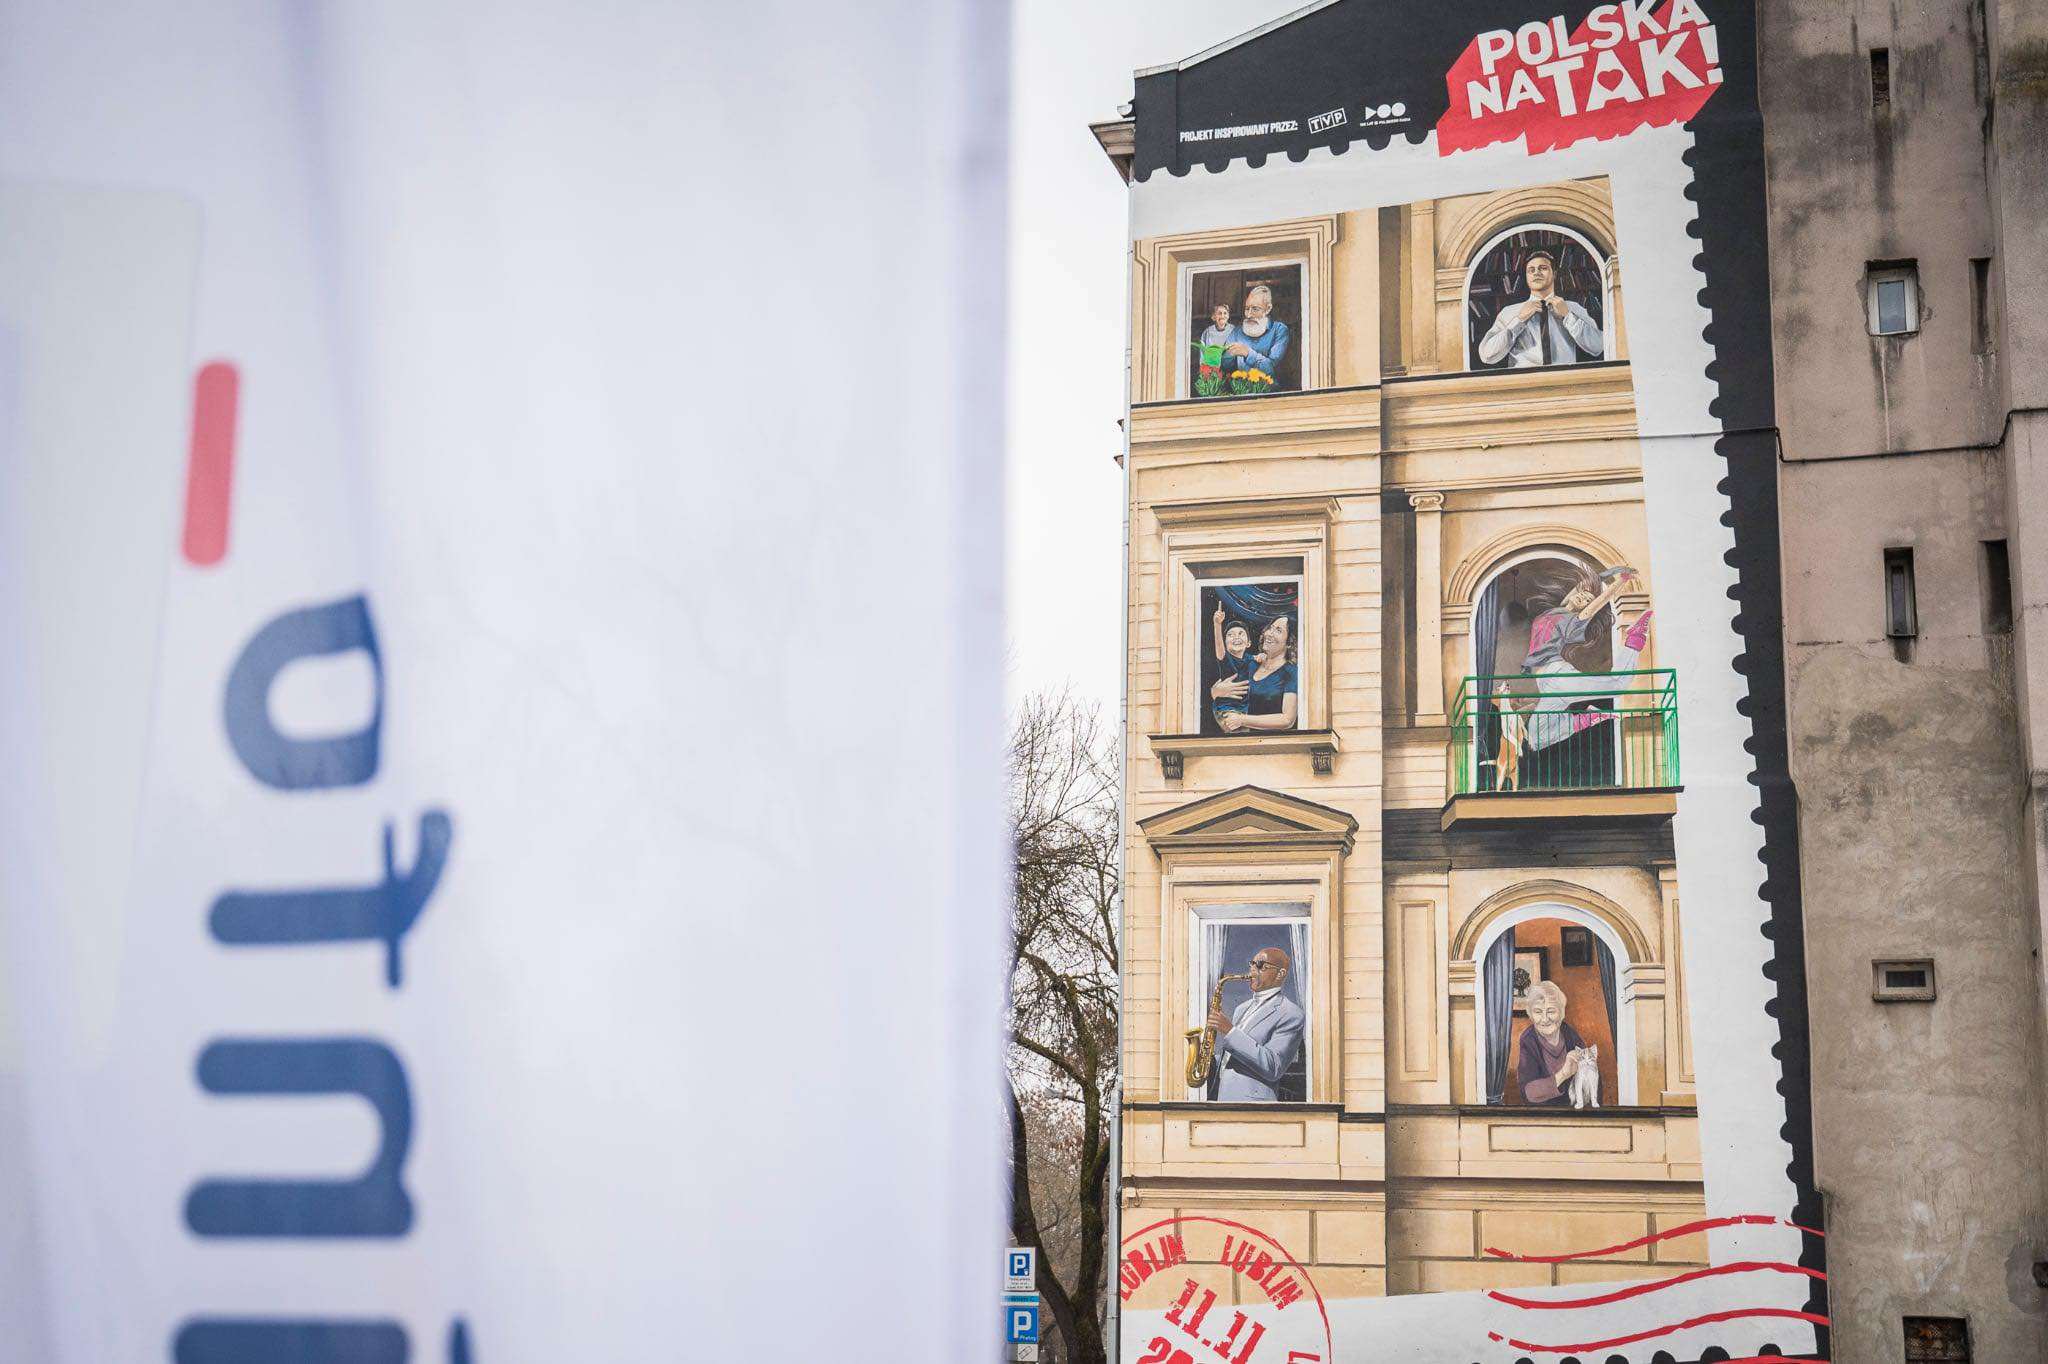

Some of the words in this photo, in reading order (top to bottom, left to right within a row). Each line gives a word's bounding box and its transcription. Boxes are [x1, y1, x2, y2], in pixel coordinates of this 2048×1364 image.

[1477, 0, 1710, 76] POLSKA
[1466, 68, 1545, 119] NA
[1536, 24, 1724, 118] TAK!
[1179, 129, 1214, 143] PROJEKT
[1214, 123, 1270, 140] INSPIROWANY
[1270, 119, 1299, 134] PRZEZ:
[1310, 110, 1344, 132] TVP
[1013, 1254, 1026, 1274] P
[1220, 1235, 1303, 1310] LUBLIN
[1013, 1310, 1032, 1339] P
